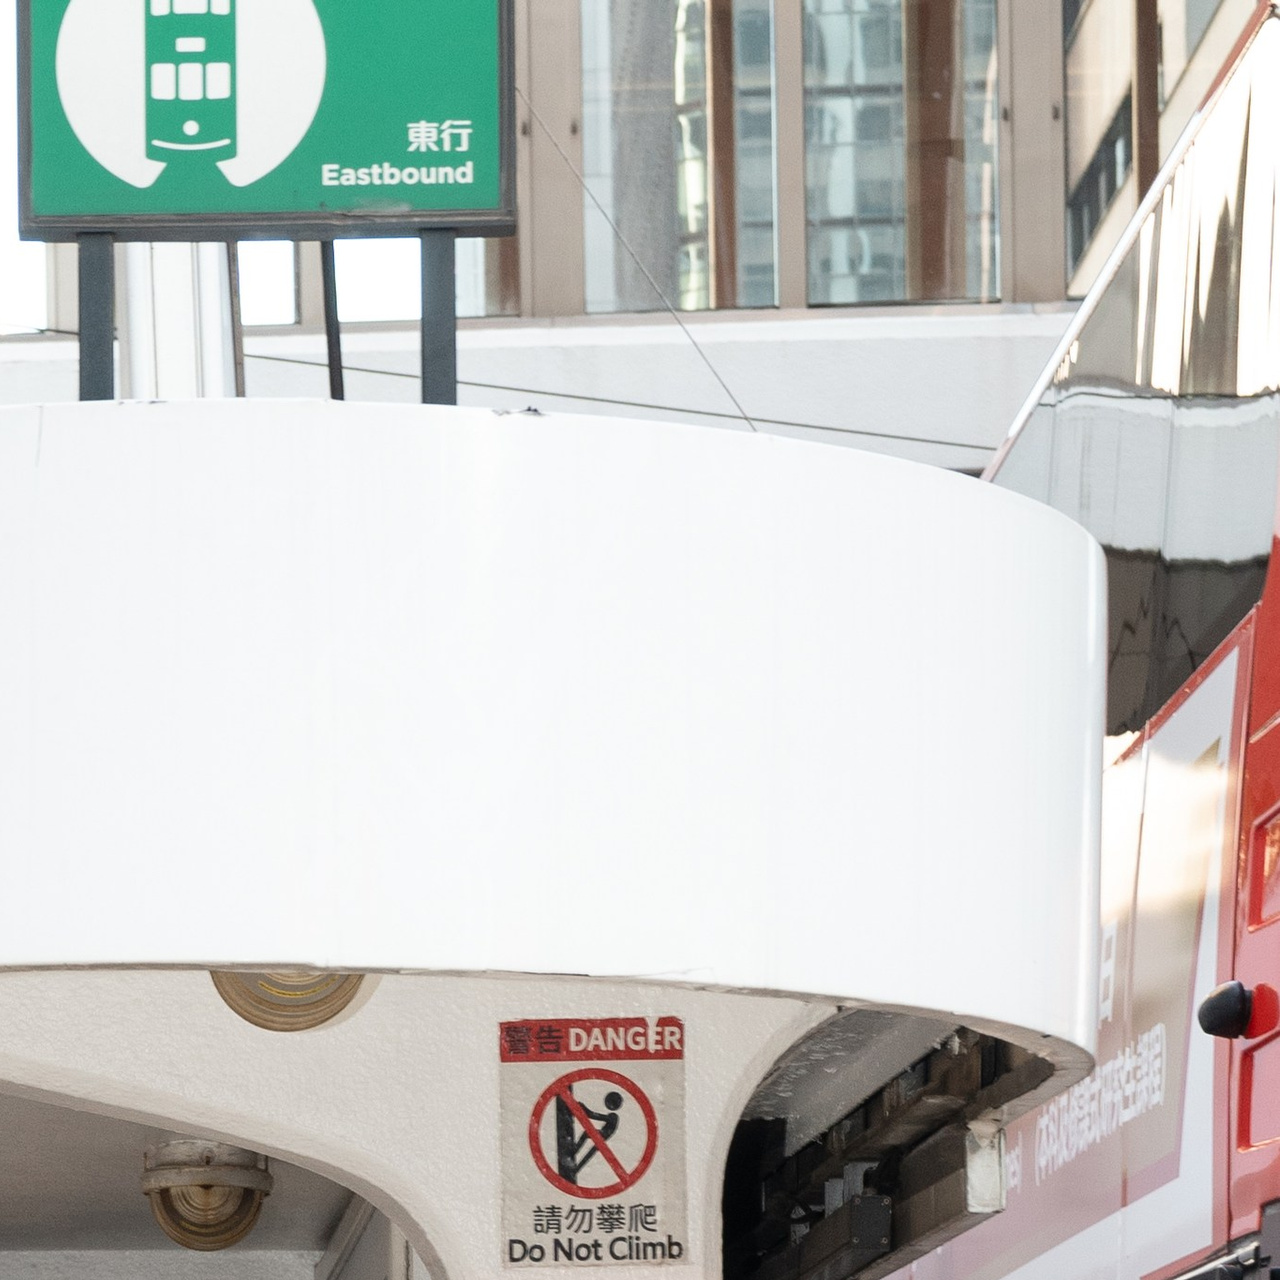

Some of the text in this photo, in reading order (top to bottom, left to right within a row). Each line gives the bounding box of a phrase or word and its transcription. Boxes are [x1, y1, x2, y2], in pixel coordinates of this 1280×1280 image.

[406, 119, 473, 152] 東行
[321, 160, 473, 186] Eastbound
[504, 1025, 683, 1055] 警告 DANGER
[533, 1203, 658, 1235] 請勿攀爬
[508, 1235, 683, 1263] Do Not Climb
